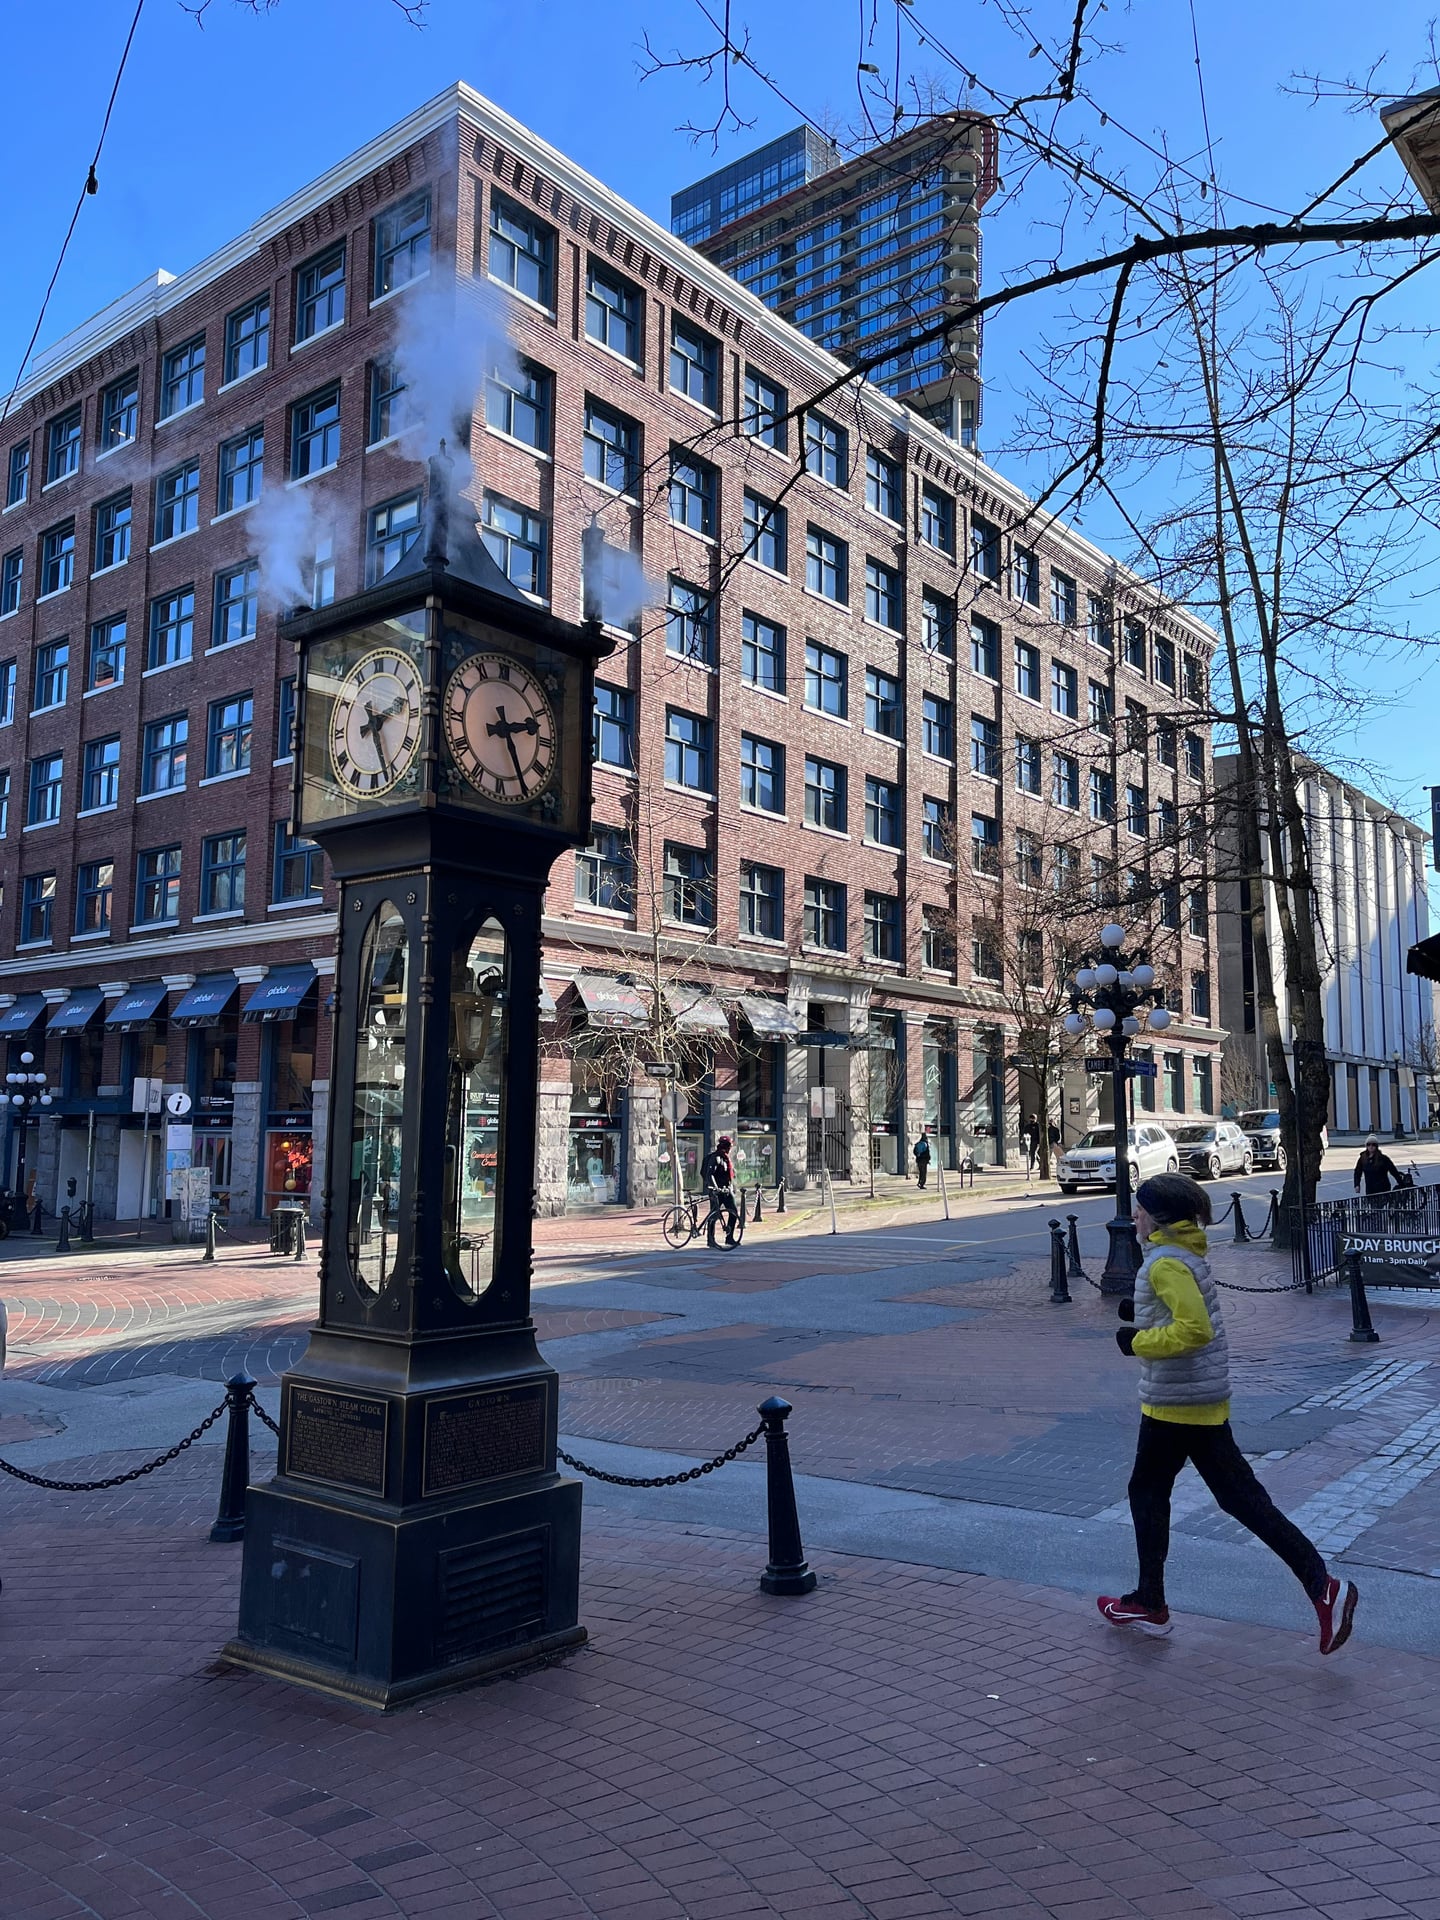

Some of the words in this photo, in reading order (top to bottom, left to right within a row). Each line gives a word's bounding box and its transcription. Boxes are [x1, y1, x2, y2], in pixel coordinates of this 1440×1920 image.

[394, 661, 400, 676] I
[522, 682, 530, 693] I
[534, 708, 546, 718] II
[539, 736, 551, 748] III
[266, 985, 290, 997] global
[1343, 1239, 1350, 1250] 7
[1354, 1239, 1380, 1251] DAY
[1384, 1240, 1440, 1253] BRUNCH
[1389, 1257, 1406, 1265] 3pm
[1408, 1258, 1427, 1266] Daily
[297, 1393, 307, 1401] THE
[310, 1394, 337, 1406] GASTOWN
[340, 1400, 358, 1411] STEAM
[361, 1404, 381, 1415] CLOCK
[468, 1394, 510, 1408] GASTOWN
